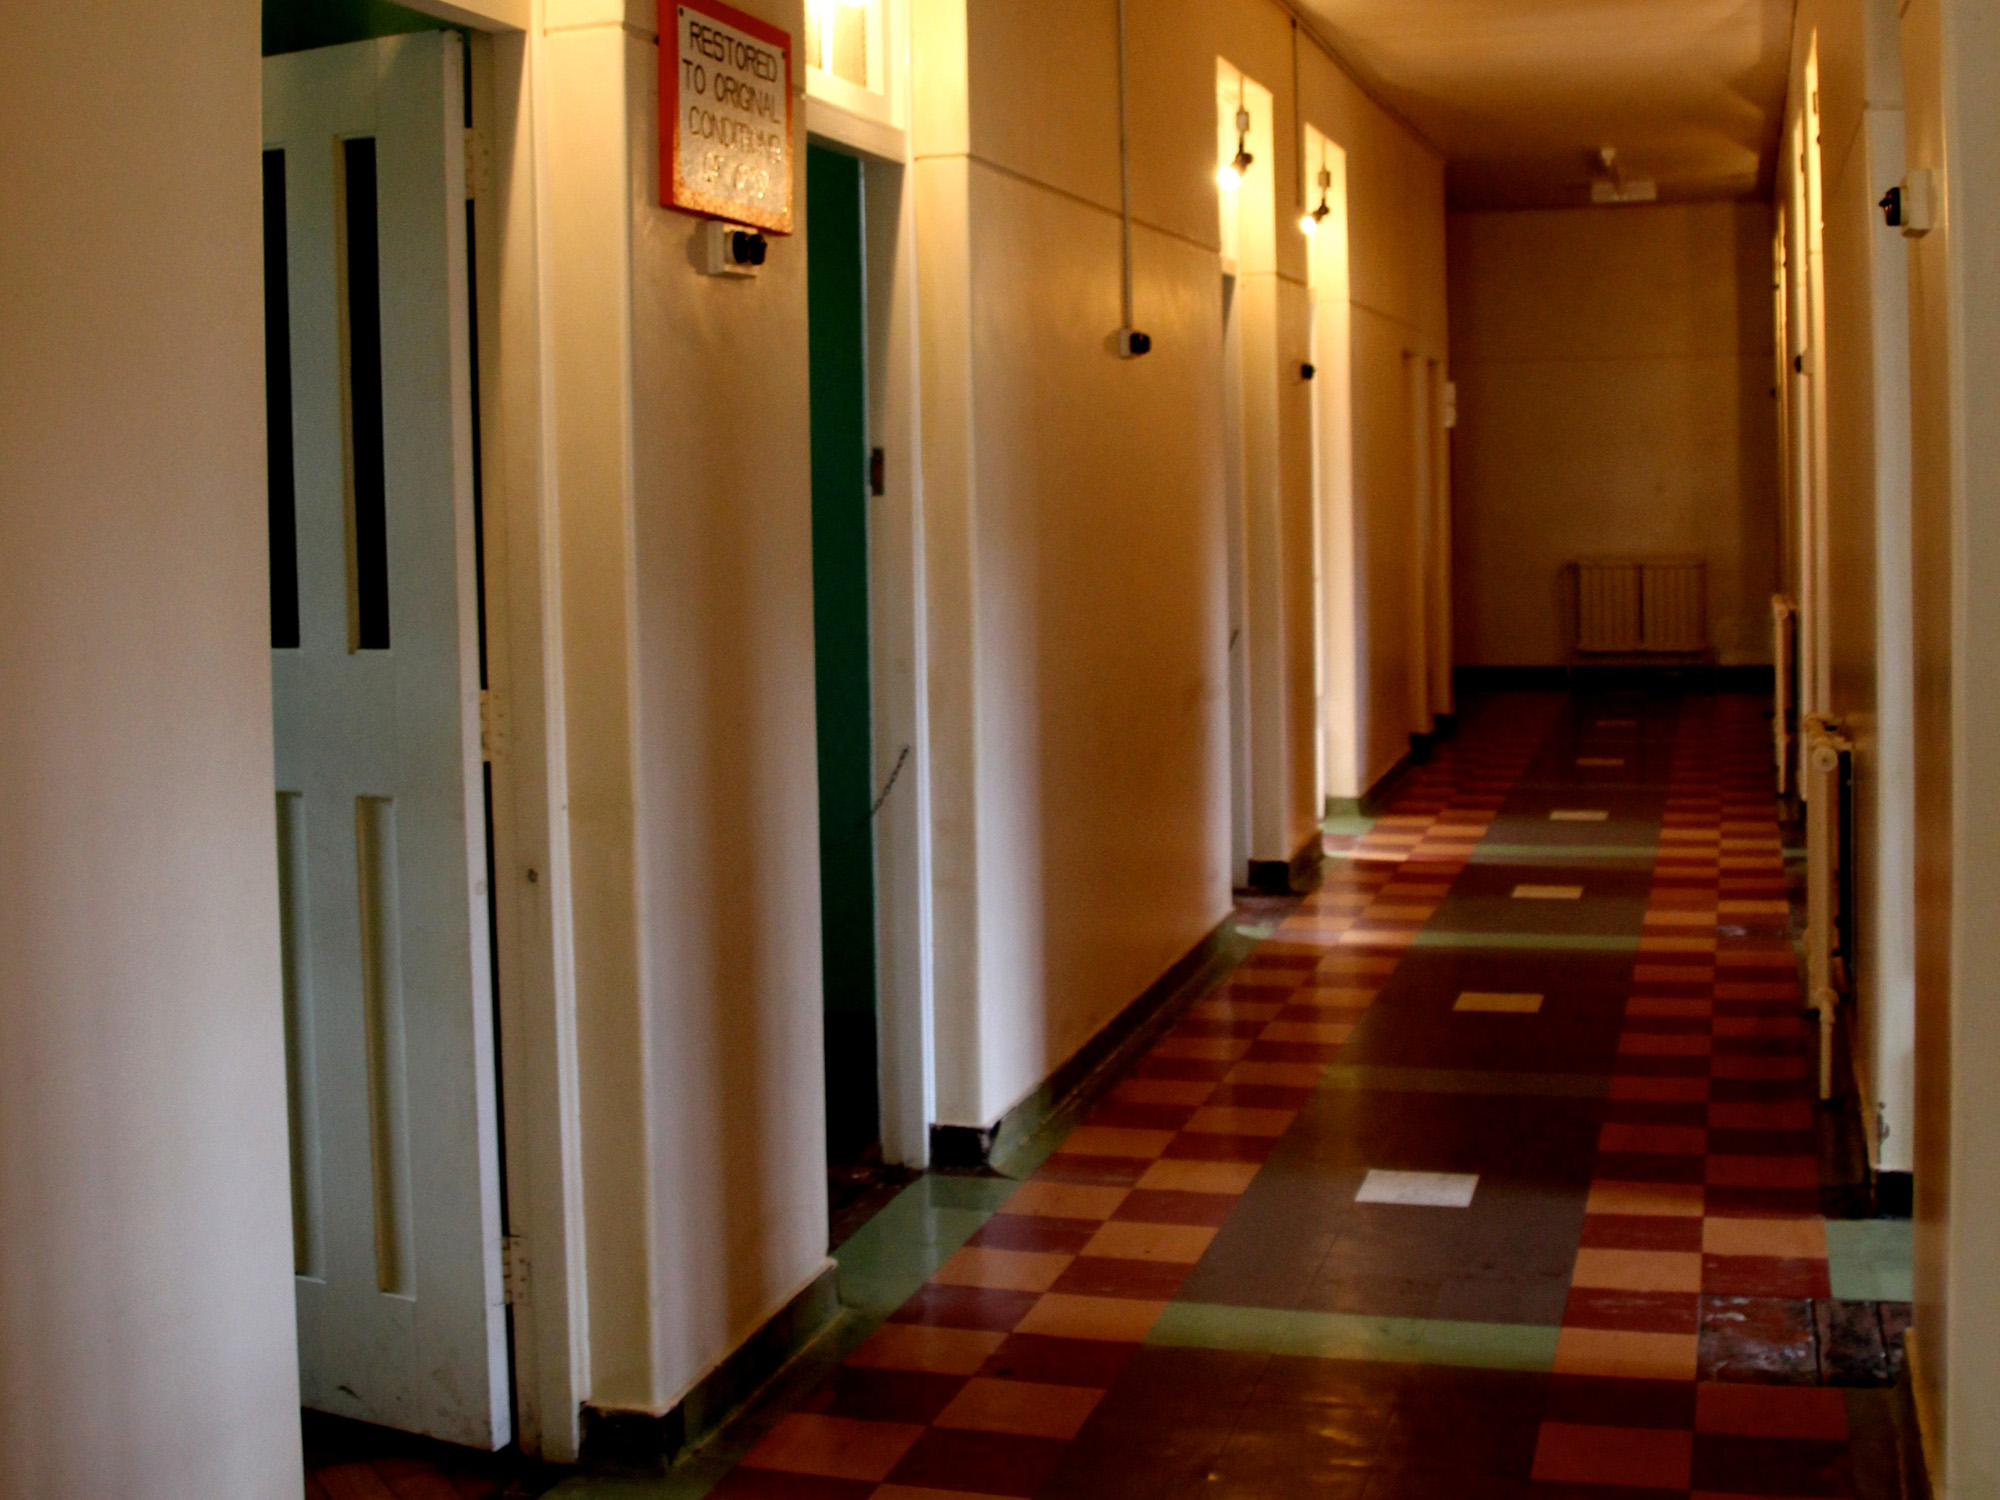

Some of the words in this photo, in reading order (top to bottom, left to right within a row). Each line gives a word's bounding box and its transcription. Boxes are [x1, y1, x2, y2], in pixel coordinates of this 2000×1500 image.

[689, 21, 777, 82] RESTORED
[682, 58, 706, 94] TO
[714, 72, 780, 123] ORIGINAL
